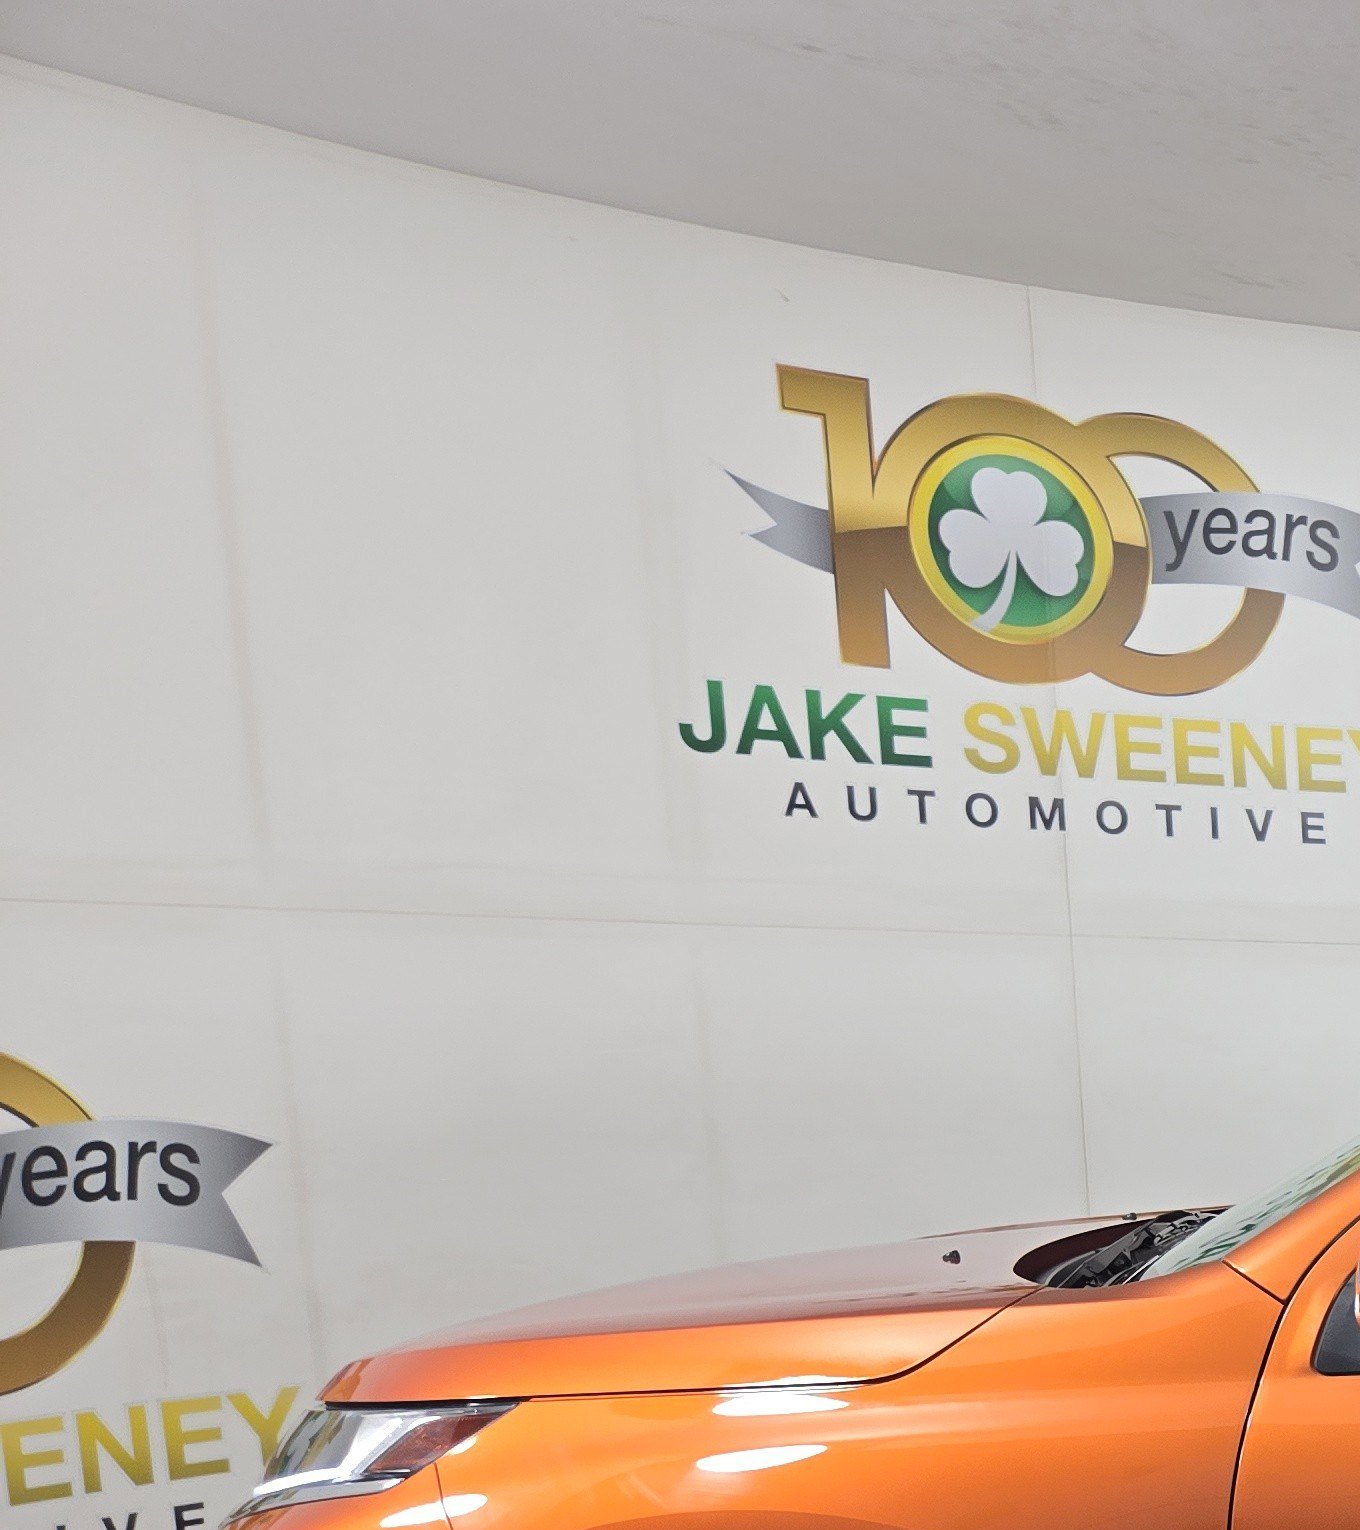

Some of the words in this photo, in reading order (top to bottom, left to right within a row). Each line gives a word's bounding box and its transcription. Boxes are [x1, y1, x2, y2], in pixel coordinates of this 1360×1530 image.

[775, 363, 1289, 698] 100
[1163, 505, 1341, 572] years
[678, 679, 934, 769] JAKE
[784, 781, 1327, 845] AUTOMOTIVE
